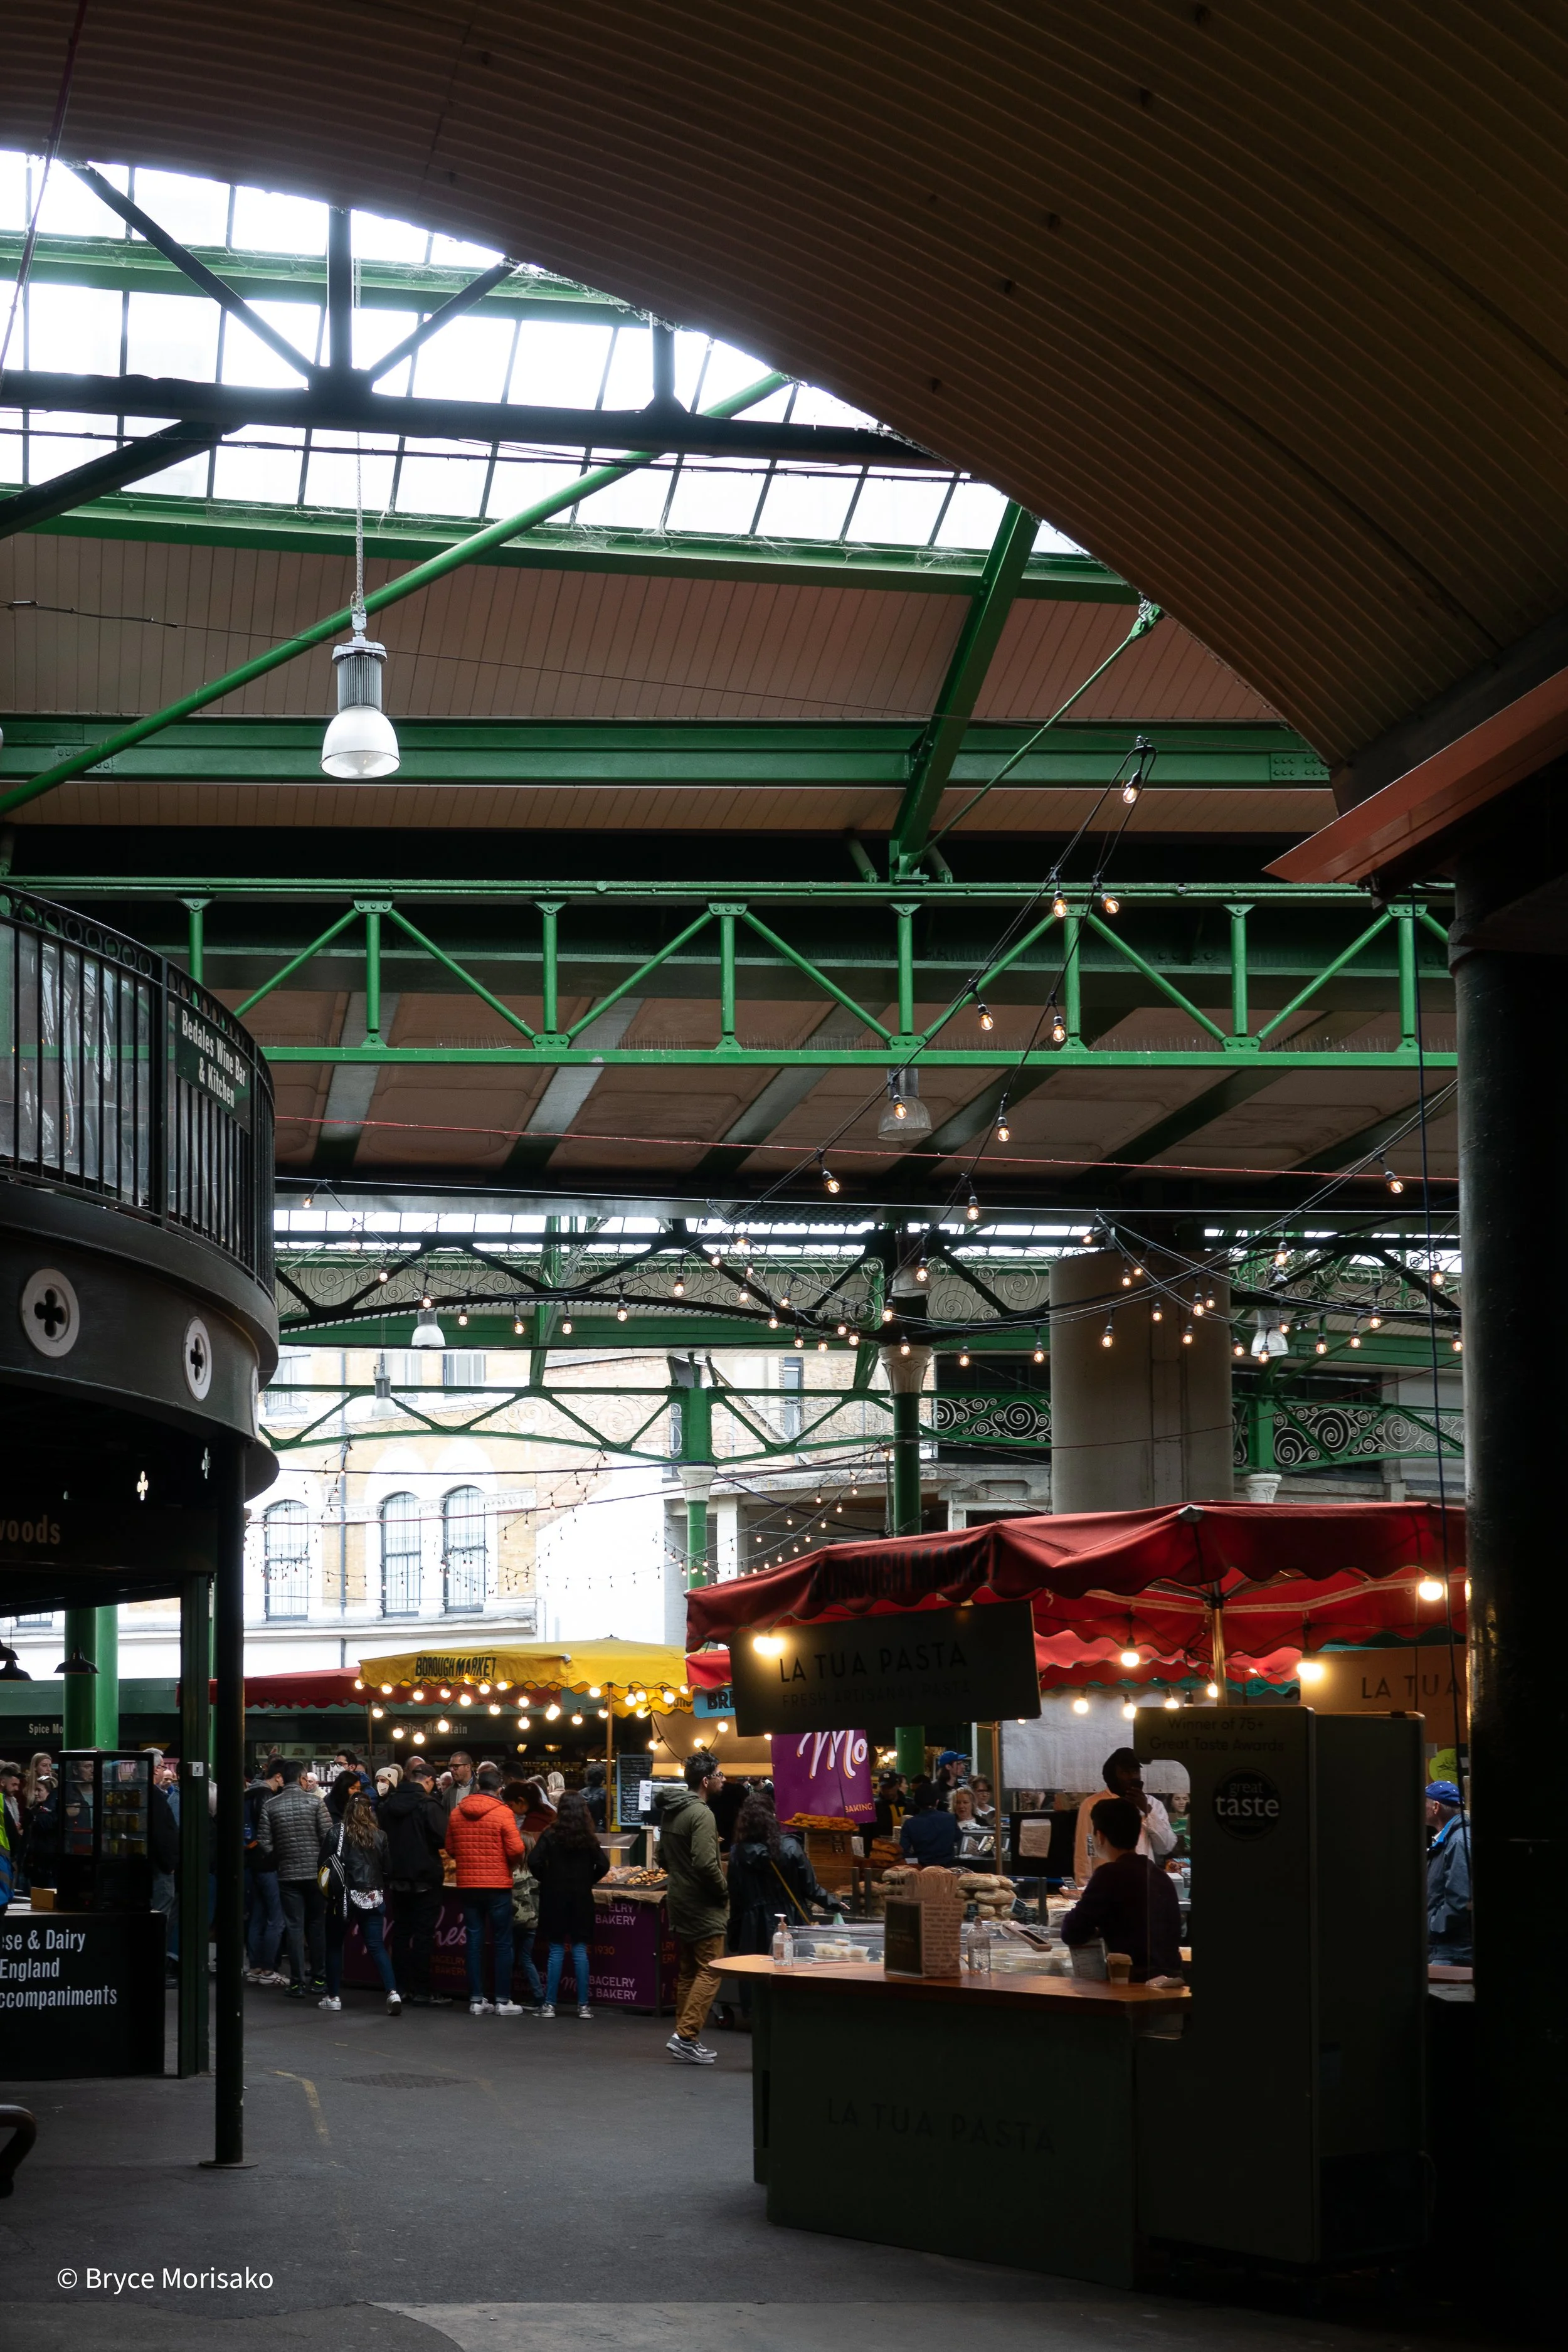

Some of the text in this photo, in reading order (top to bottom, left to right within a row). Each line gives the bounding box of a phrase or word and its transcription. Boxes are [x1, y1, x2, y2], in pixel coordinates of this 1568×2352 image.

[182, 1009, 246, 1087] Bedales Wine Bar
[198, 1057, 235, 1108] & Kitchen
[415, 1656, 497, 1678] BOROUGH MARKET
[780, 1640, 968, 1683] LA TUA PASTA
[1362, 1674, 1462, 1698] LA TUA
[783, 1690, 827, 1708] FRESH
[28, 1723, 50, 1736] Spice
[425, 1723, 468, 1735] Motain
[1168, 1717, 1264, 1731] Winner of 75+
[1150, 1736, 1285, 1752] Great Taste Awards
[1228, 1781, 1264, 1797] great
[1214, 1795, 1280, 1818] taste
[608, 1903, 633, 1913] ELRY
[595, 1914, 637, 1926] BAKERY
[27, 1929, 41, 1951] &
[45, 1929, 86, 1952] Dairy
[594, 1945, 615, 1956] 1930
[0, 1957, 61, 1982] England
[589, 1976, 635, 1988] BAGELRY
[596, 1987, 637, 2001] BAKERY
[828, 2097, 1056, 2156] LA TUA PASTA
